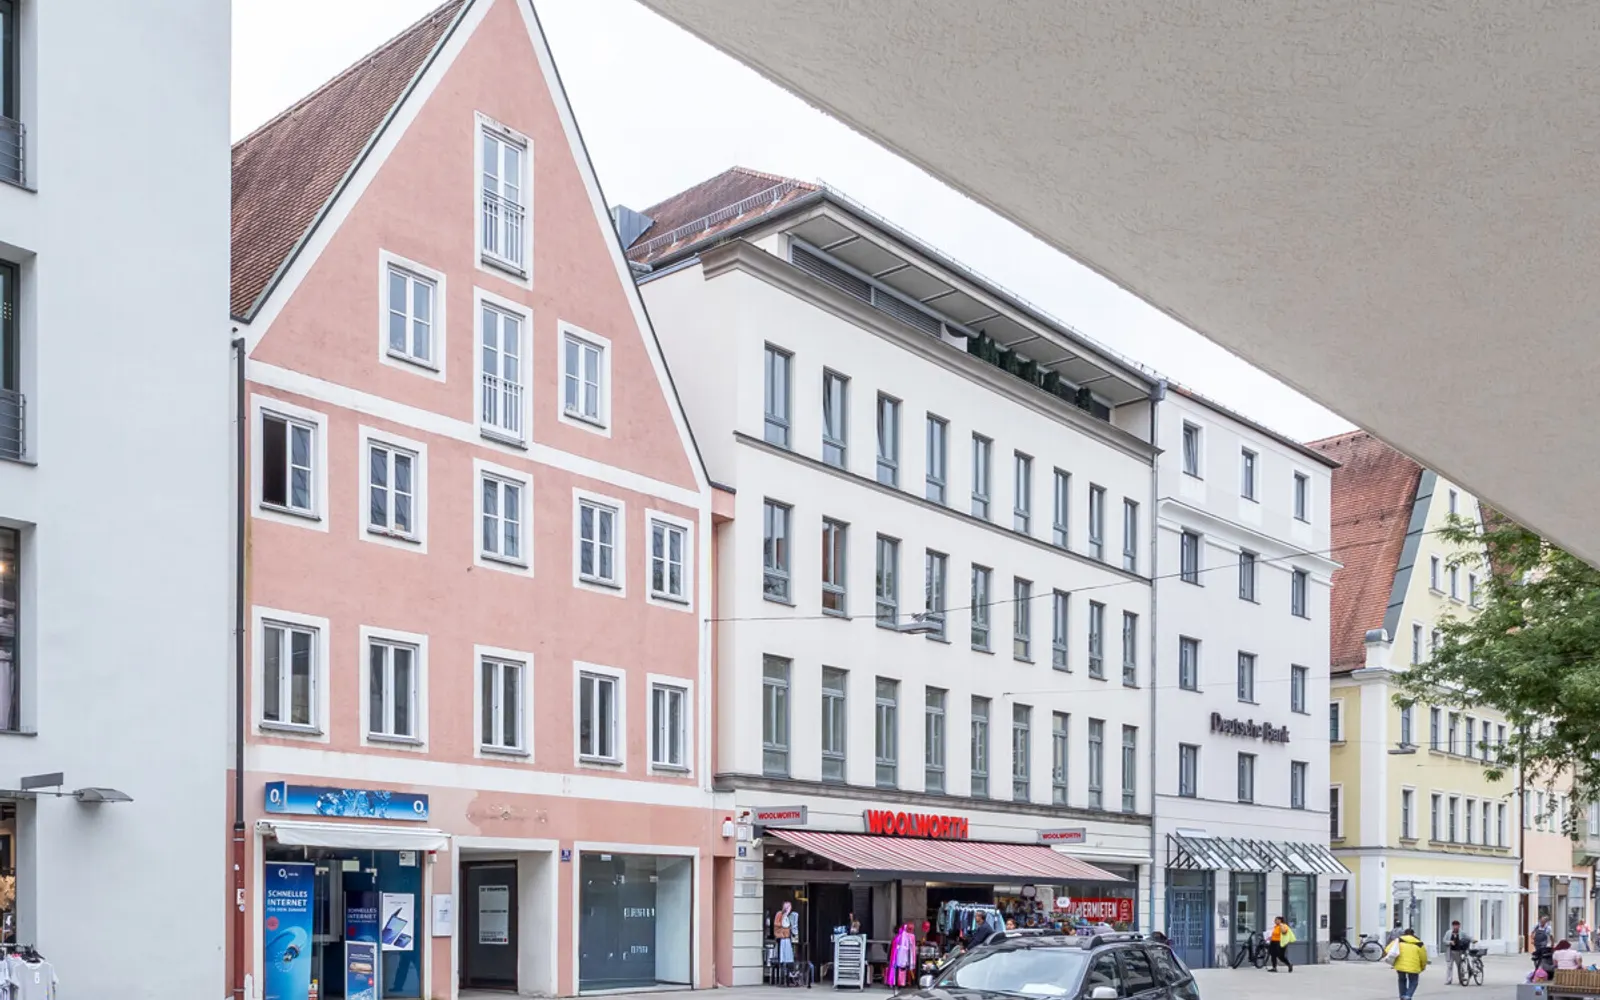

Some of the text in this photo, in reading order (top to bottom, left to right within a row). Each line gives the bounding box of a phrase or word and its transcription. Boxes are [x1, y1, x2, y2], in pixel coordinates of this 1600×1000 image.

[1210, 712, 1290, 742] Deutsche Bank
[757, 811, 800, 820] WOOLWORTH
[866, 809, 969, 839] WOOLWORTH
[1042, 832, 1081, 840] WOOLWORTH
[267, 889, 308, 898] SCHNELLES
[266, 898, 308, 907] INTERNET
